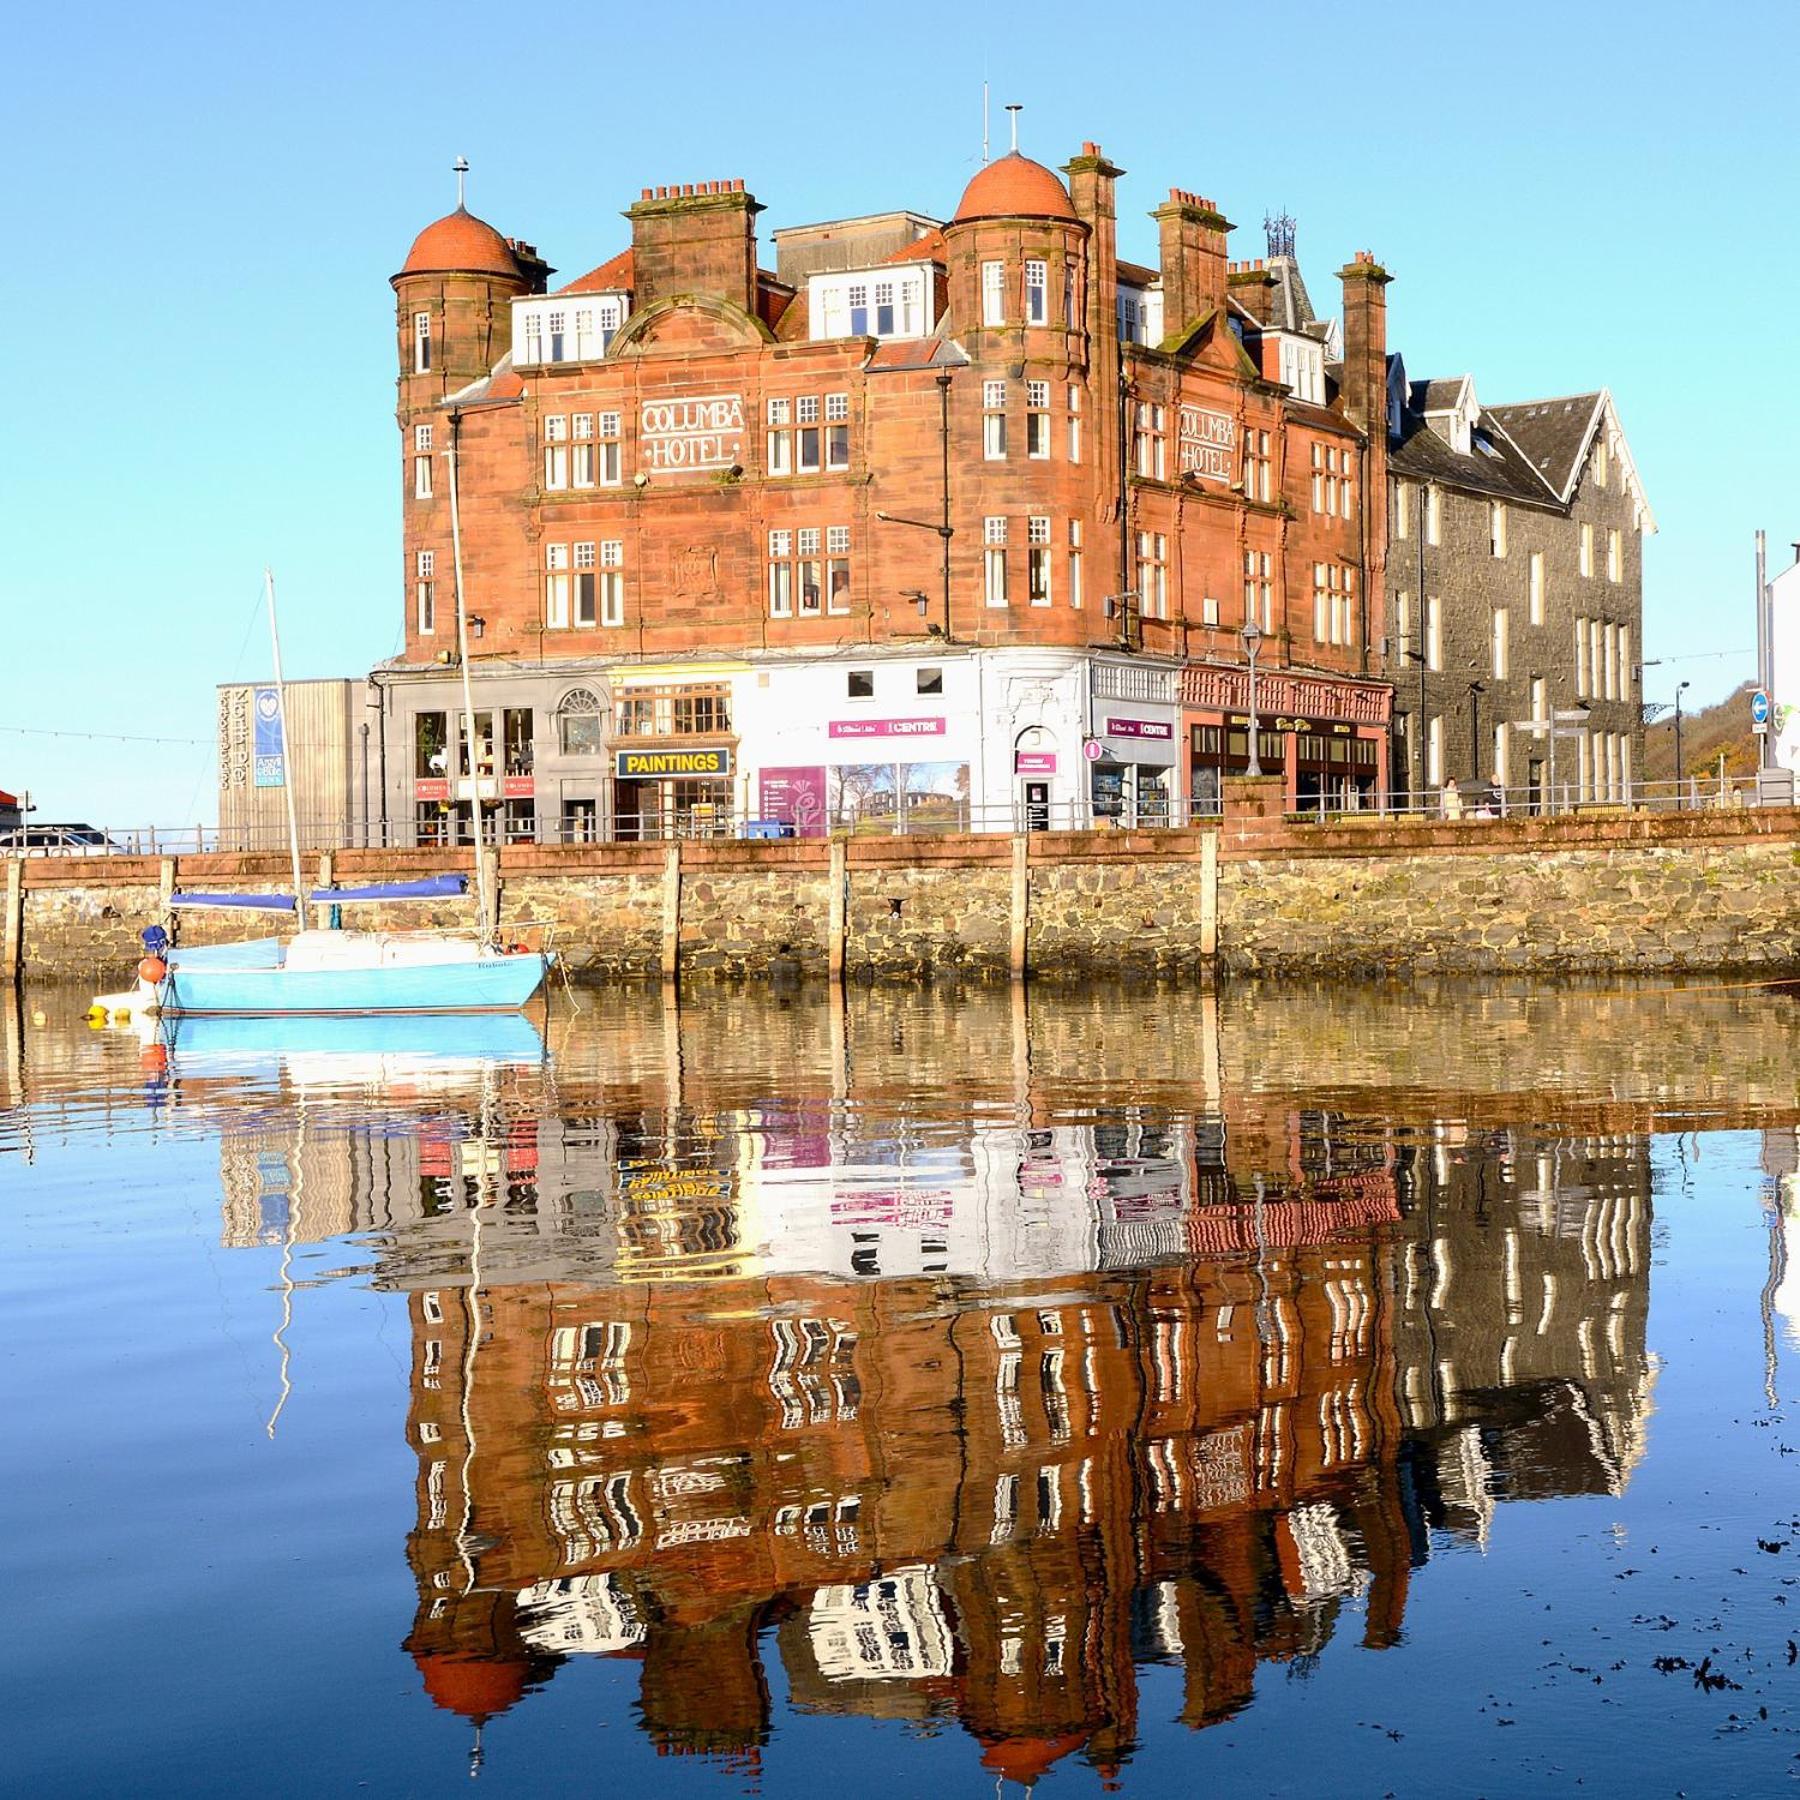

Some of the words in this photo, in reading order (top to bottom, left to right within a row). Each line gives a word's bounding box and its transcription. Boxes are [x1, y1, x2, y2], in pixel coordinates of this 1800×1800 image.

[641, 401, 744, 432] COLUMBA
[652, 435, 734, 466] HOTEL
[1184, 443, 1230, 476] HOTEL
[232, 689, 249, 745] North
[232, 750, 249, 787] Pier
[627, 752, 719, 773] PAINTINGS
